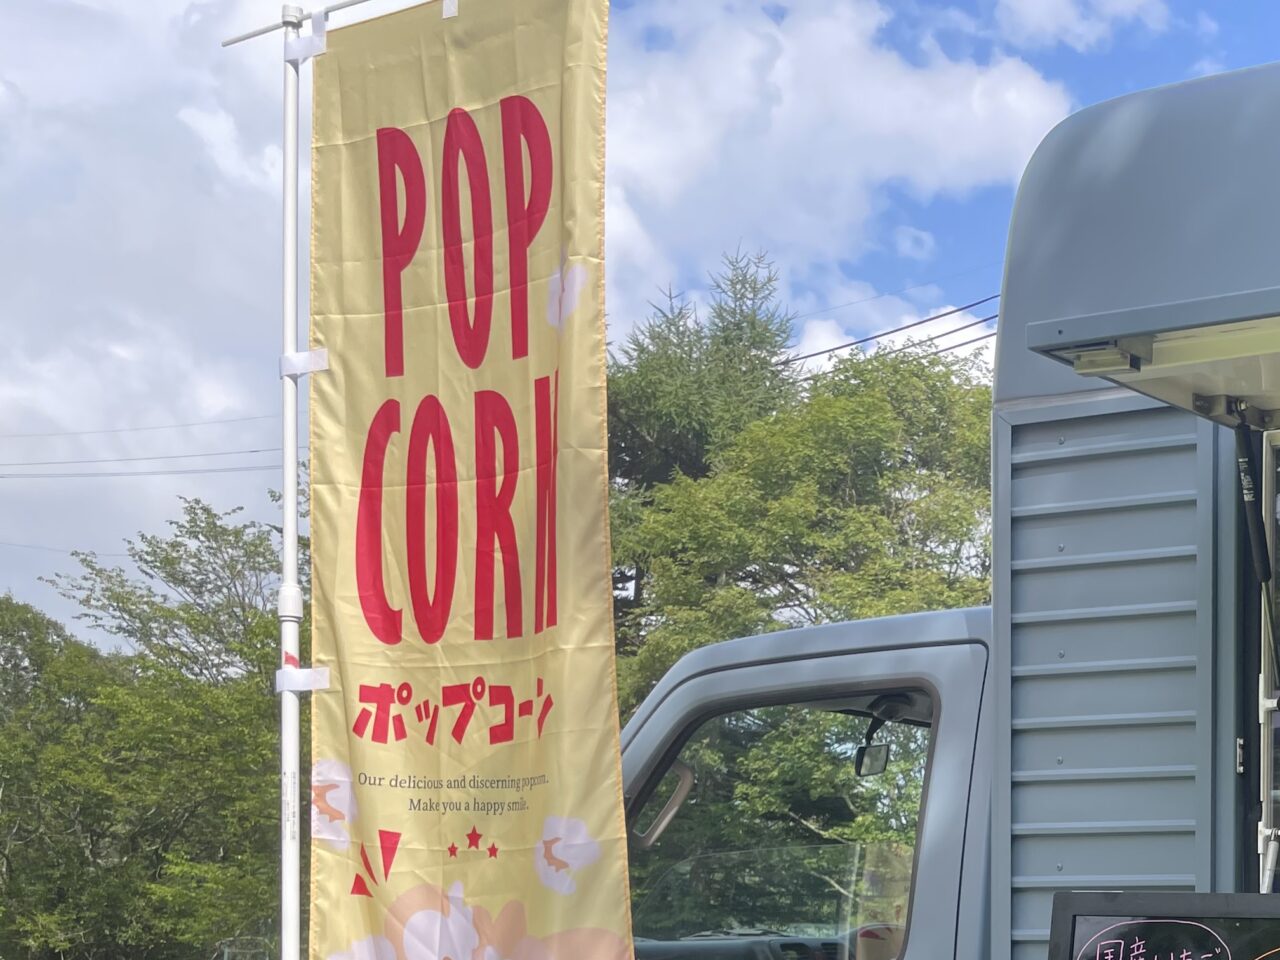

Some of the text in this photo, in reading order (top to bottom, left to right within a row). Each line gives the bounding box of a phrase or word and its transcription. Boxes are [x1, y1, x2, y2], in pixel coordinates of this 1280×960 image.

[376, 96, 553, 377] POP
[355, 371, 559, 646] CORN
[352, 676, 554, 746] ポップコーン
[358, 772, 385, 787] Our
[389, 774, 444, 790] delicious
[446, 775, 466, 789] and
[468, 775, 521, 793] discerning
[408, 798, 441, 812] Make
[442, 802, 462, 815] you
[464, 802, 470, 812] a
[473, 798, 505, 815] happy
